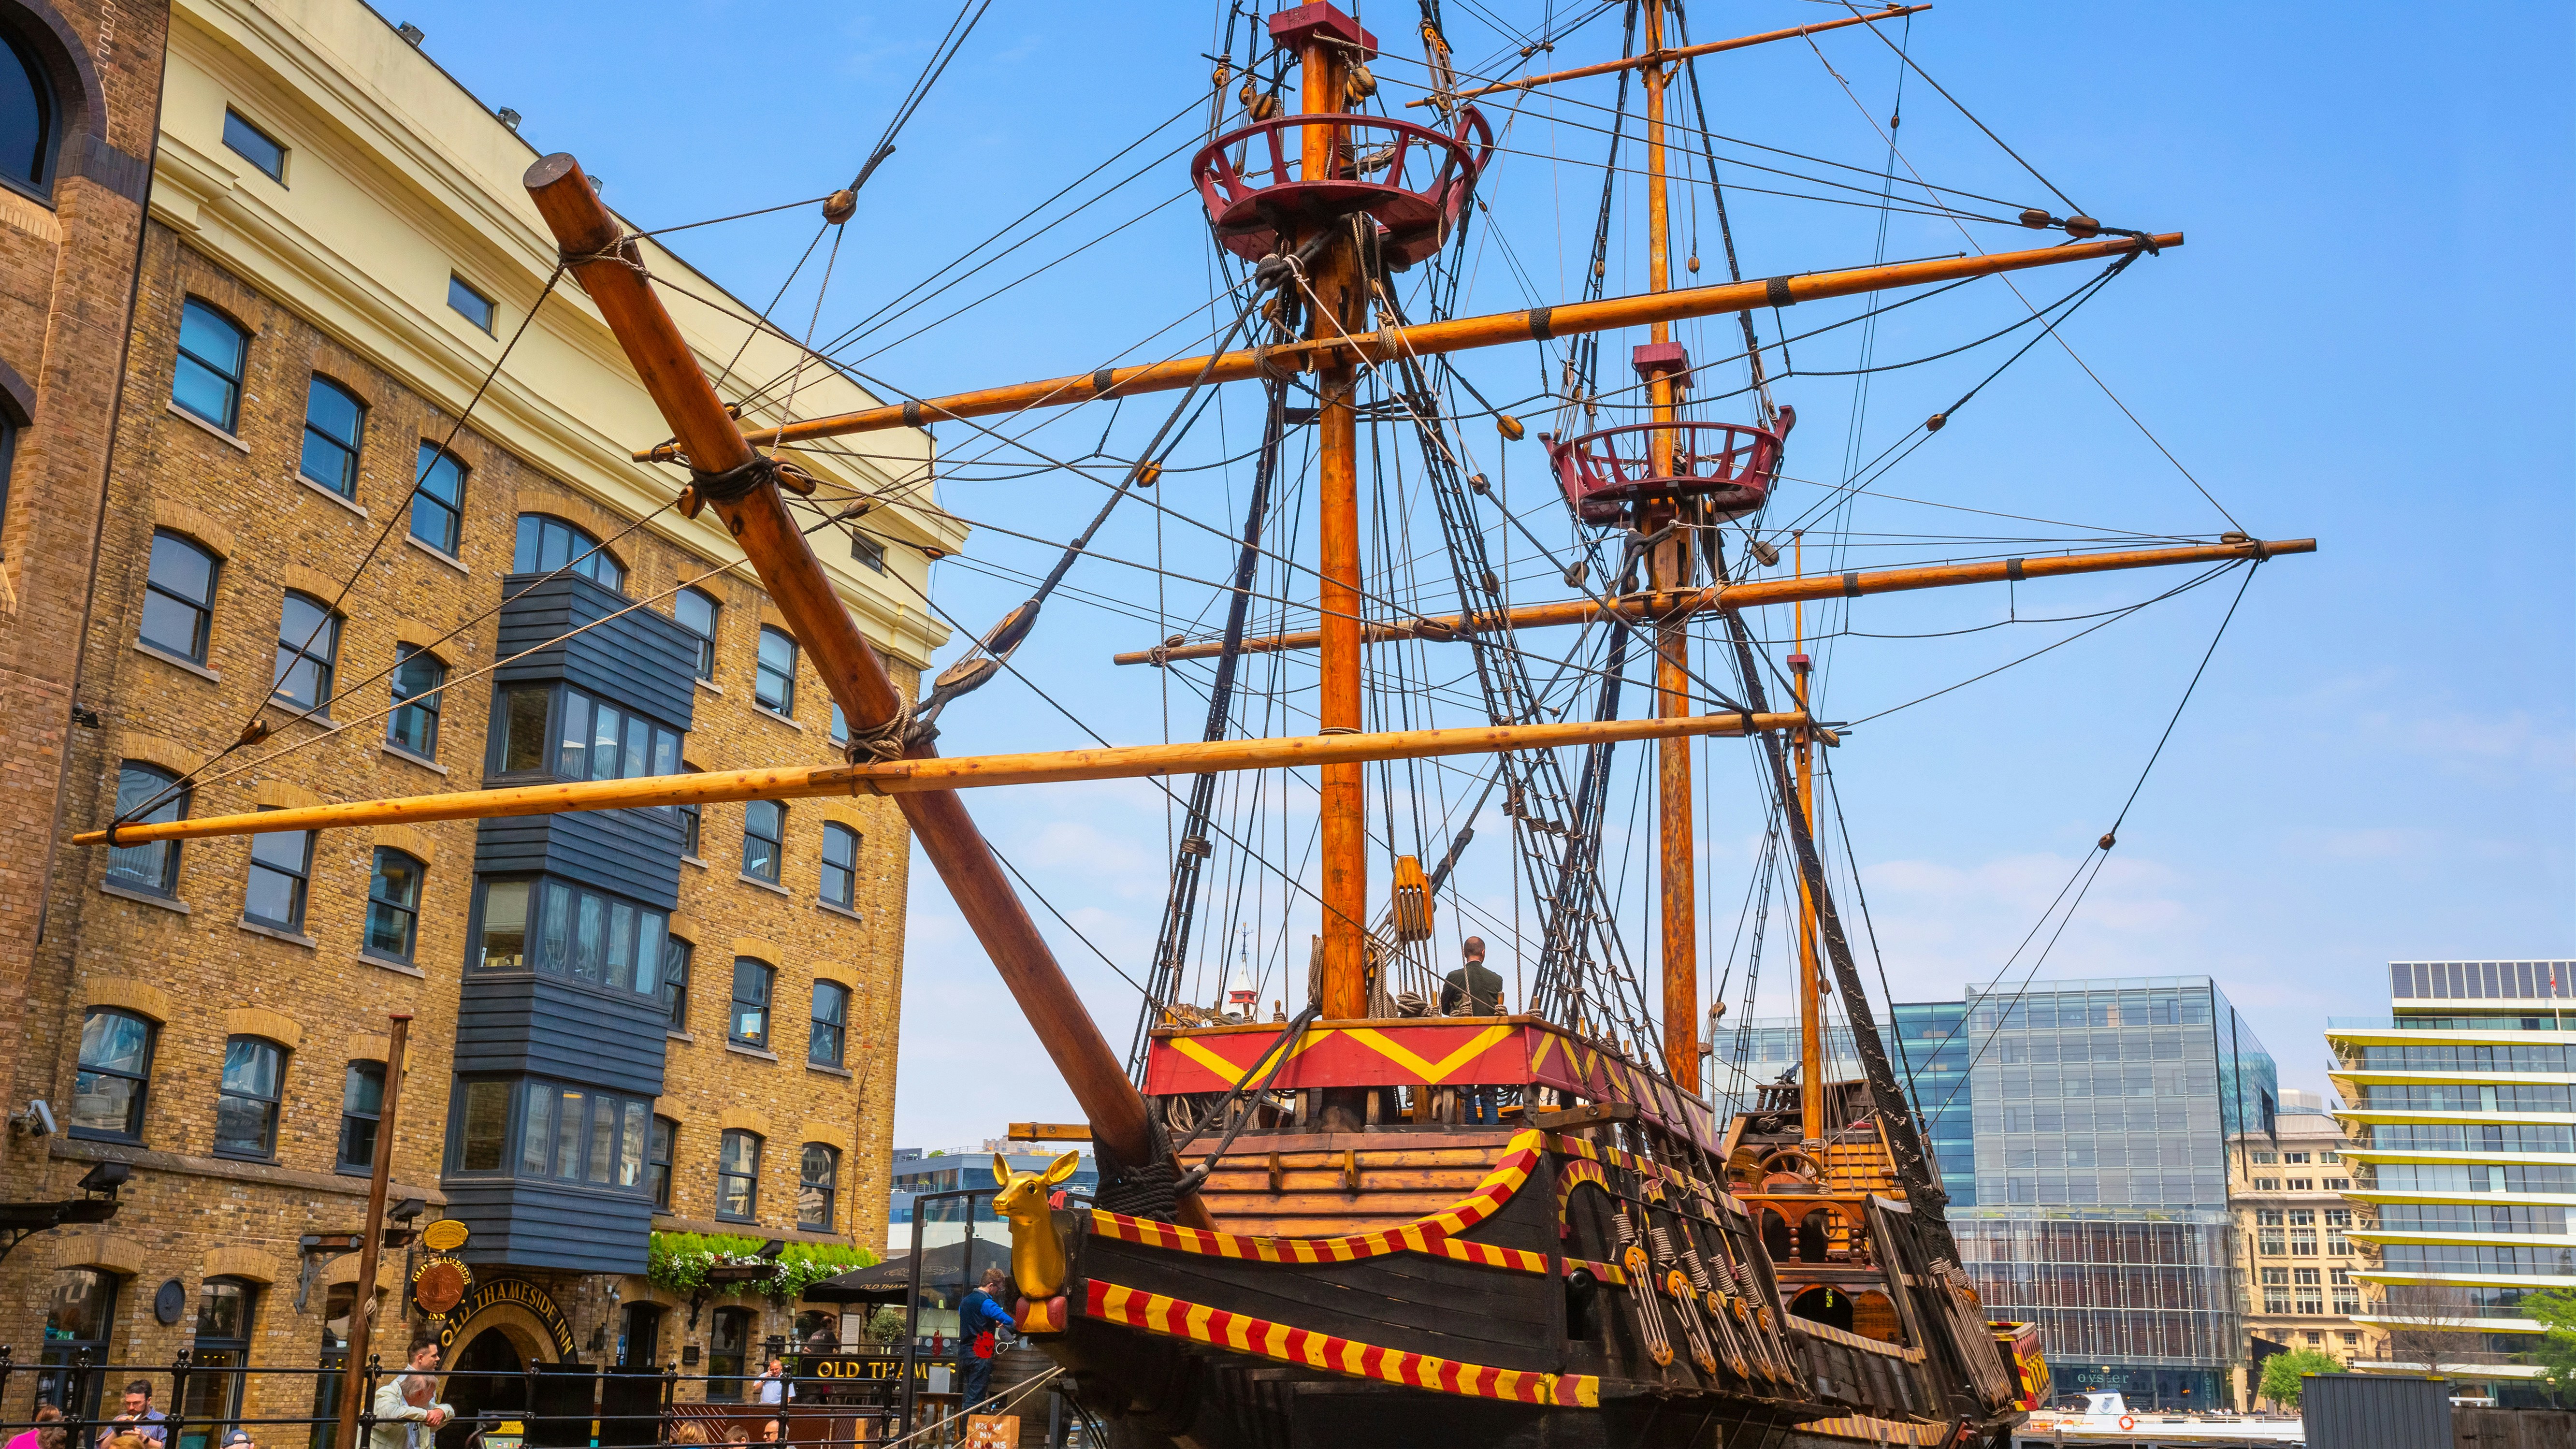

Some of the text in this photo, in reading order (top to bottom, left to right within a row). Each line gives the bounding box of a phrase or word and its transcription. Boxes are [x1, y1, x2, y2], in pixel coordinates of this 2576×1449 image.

[413, 1257, 471, 1285] OLD AMESIDE
[441, 1281, 574, 1355] OLD THAMESIDE INN
[817, 1362, 860, 1378] OLD
